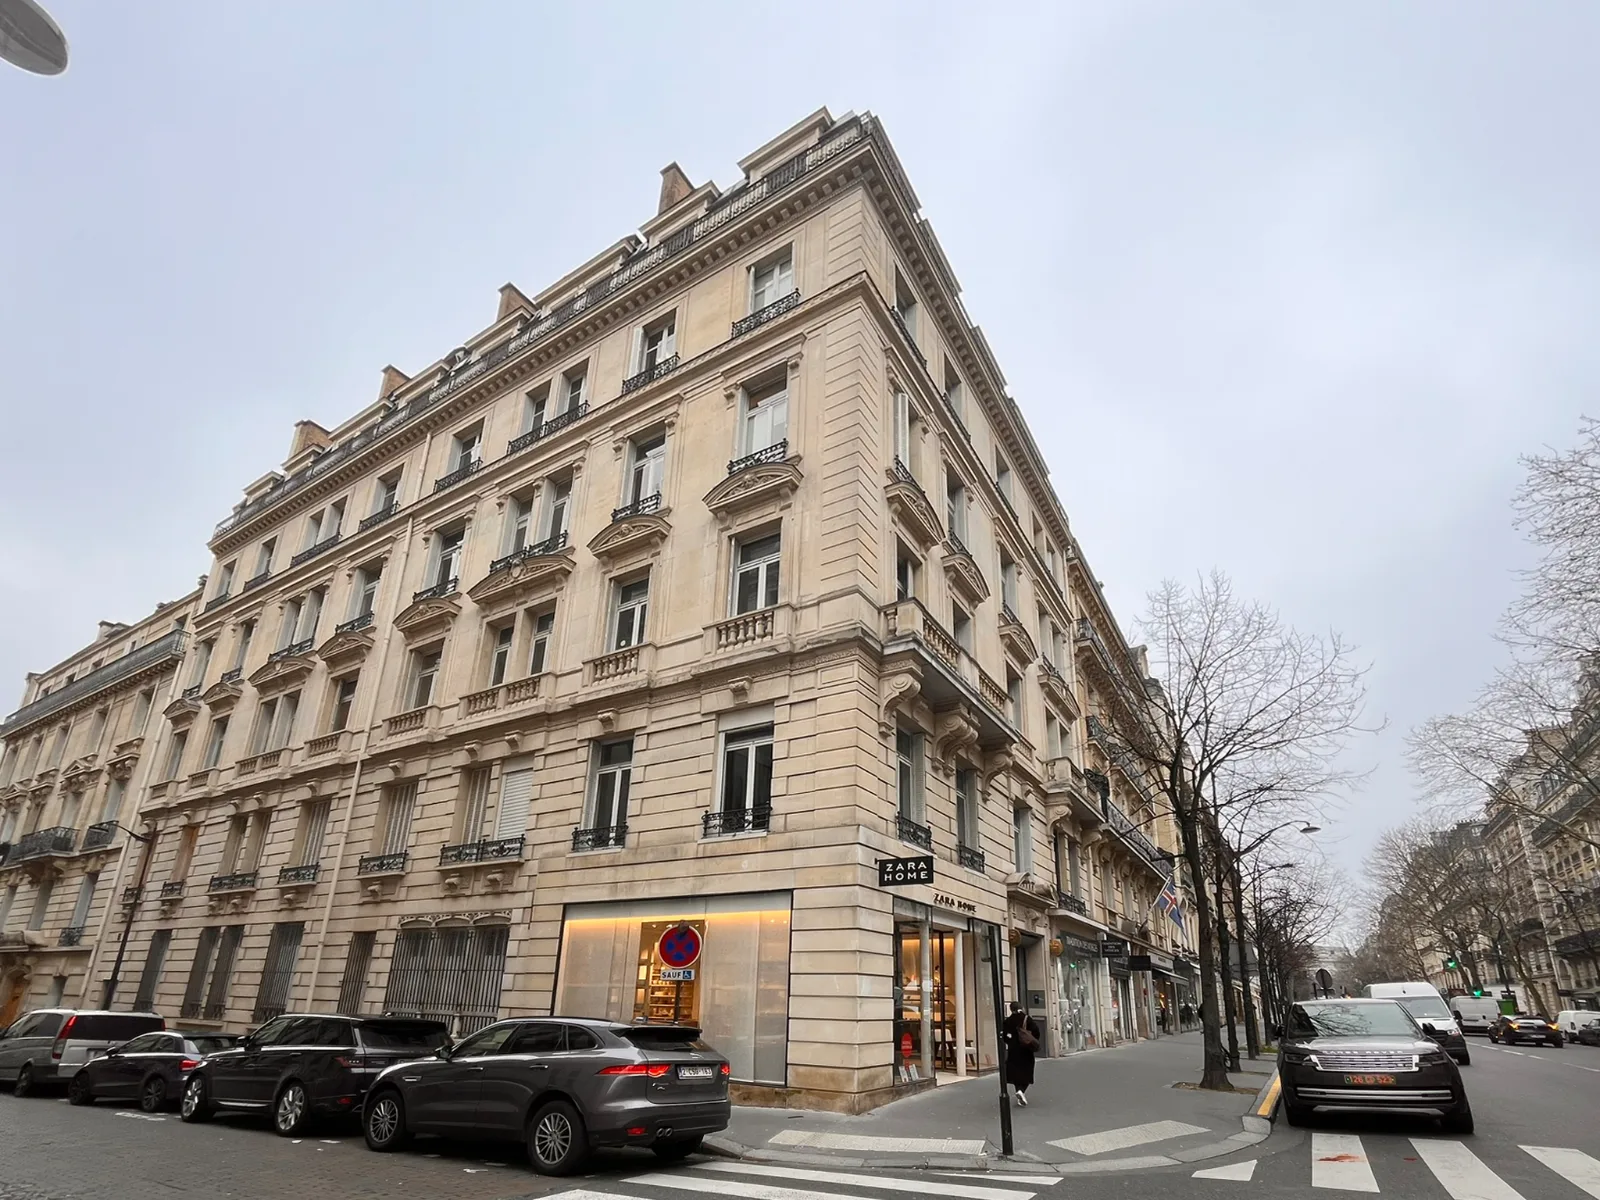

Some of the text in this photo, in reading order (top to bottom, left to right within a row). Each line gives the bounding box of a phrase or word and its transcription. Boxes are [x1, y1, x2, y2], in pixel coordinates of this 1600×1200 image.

[886, 862, 927, 872] ZARA
[884, 871, 928, 882] HOME
[933, 893, 977, 913] ZARA HOME
[662, 971, 681, 979] SAUF
